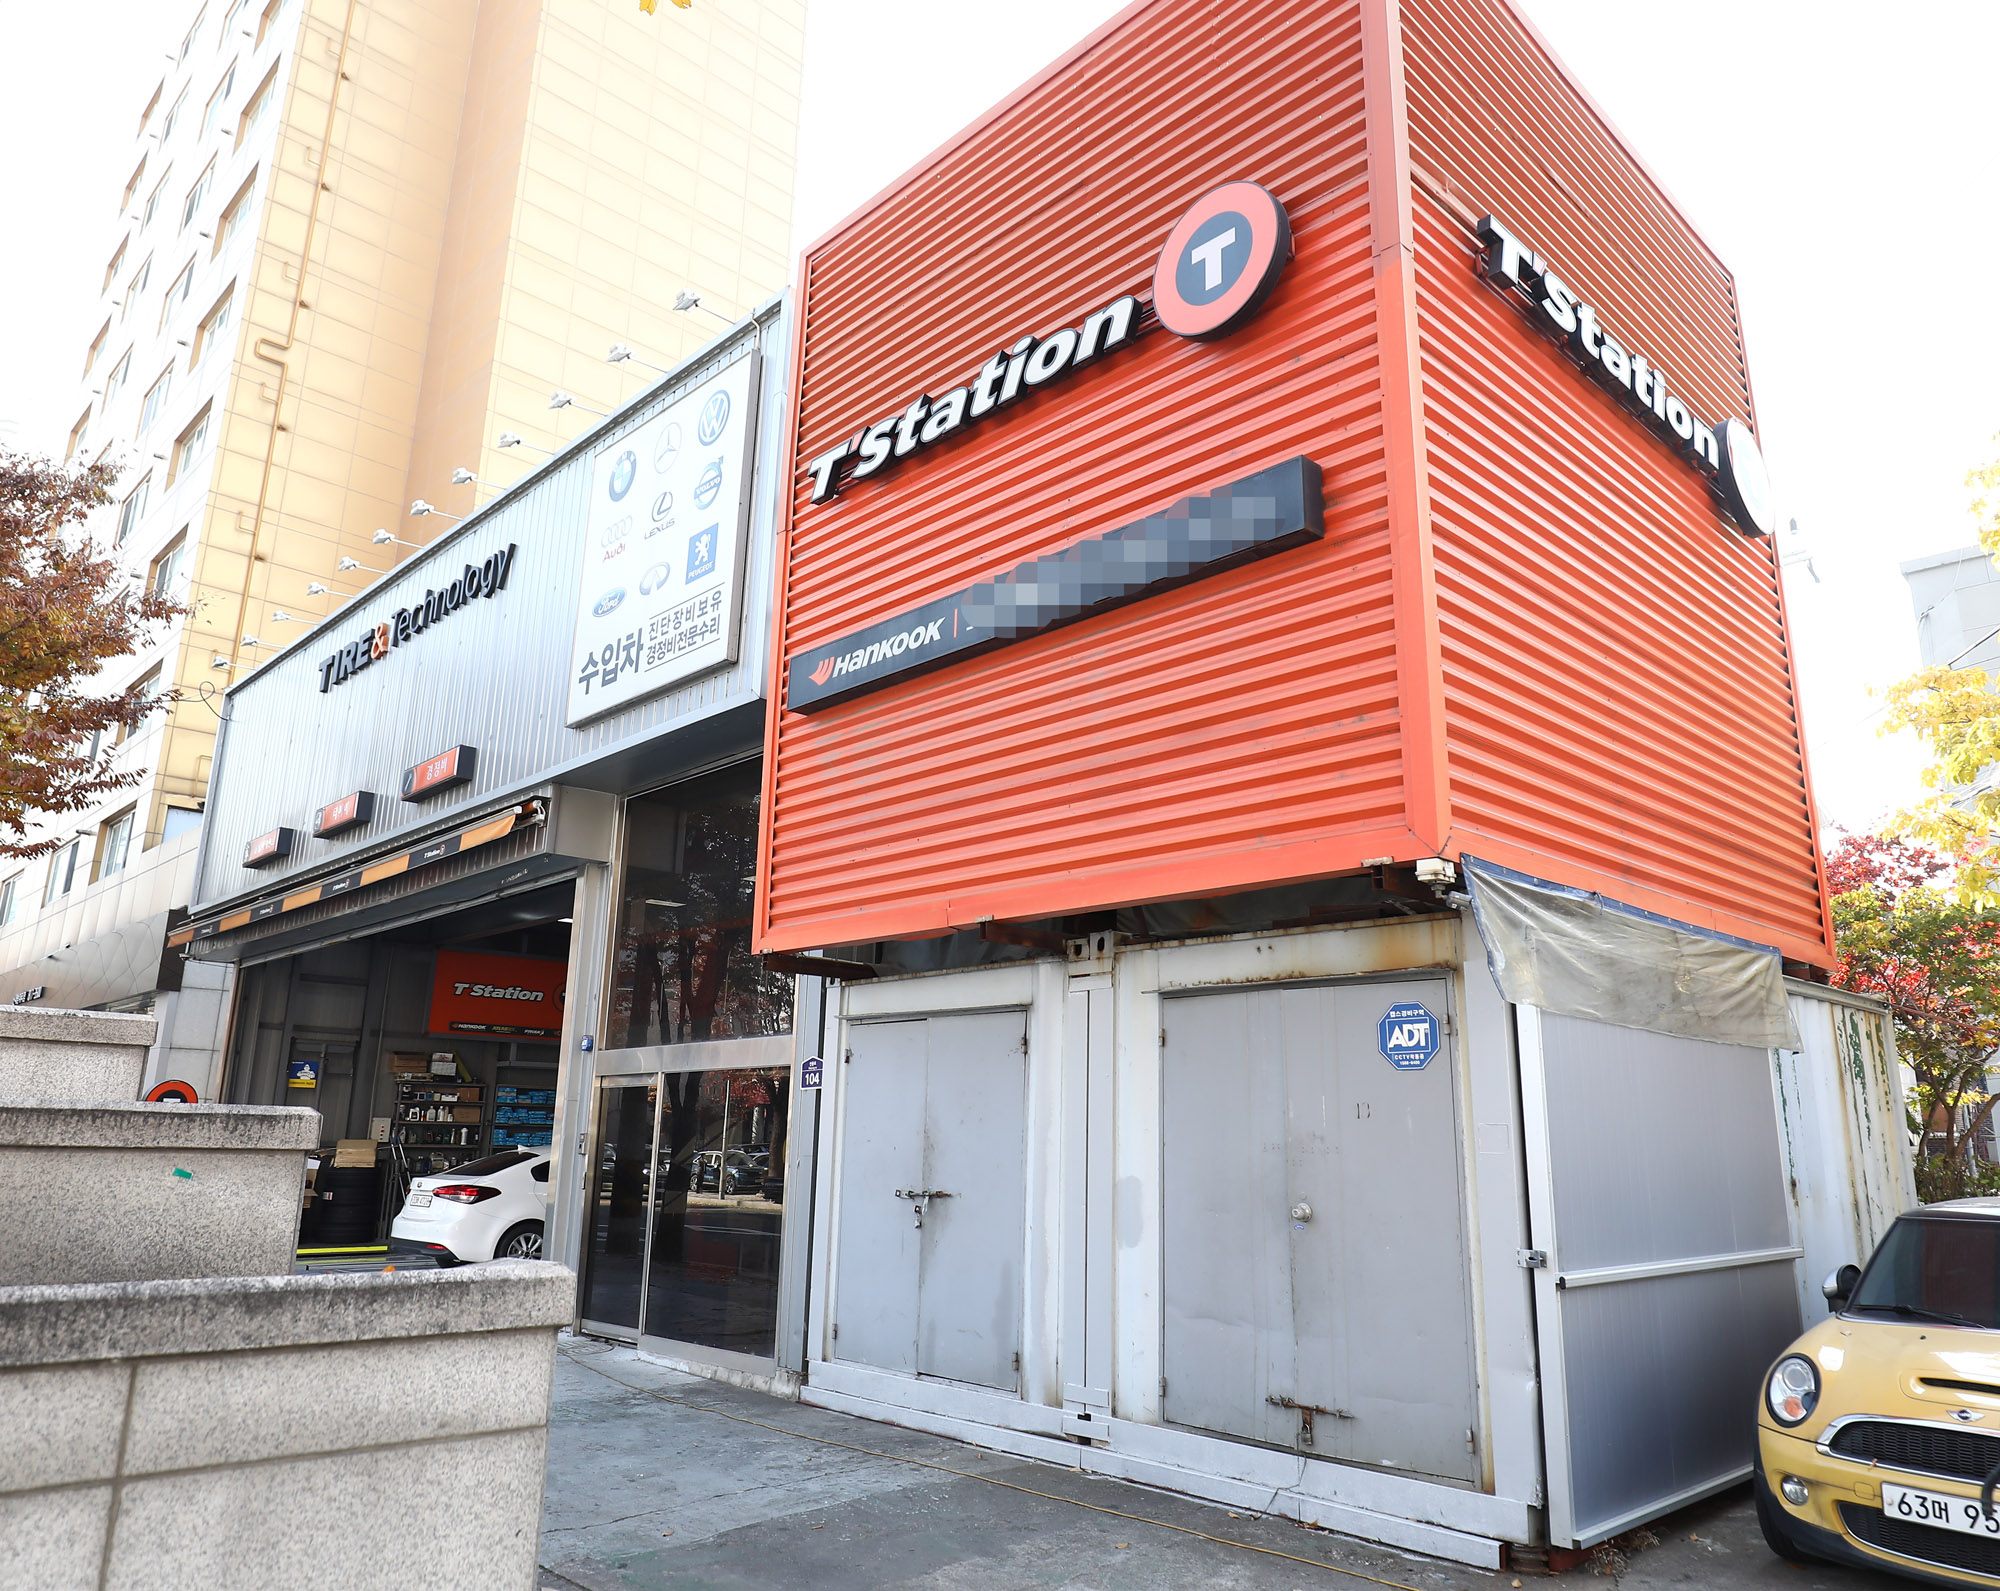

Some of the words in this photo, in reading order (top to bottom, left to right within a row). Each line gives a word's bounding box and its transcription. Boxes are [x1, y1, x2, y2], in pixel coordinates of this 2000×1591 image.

[1191, 228, 1237, 290] T
[1487, 213, 1722, 472] T'Station
[808, 294, 1140, 505] T'Station
[695, 477, 722, 495] VOLVO
[644, 518, 676, 540] LEXUS
[688, 561, 714, 580] PEUGEOT
[578, 627, 644, 695] 수입차
[453, 982, 544, 1002] T'Station
[1388, 1023, 1429, 1048] ADT
[805, 1073, 820, 1085] 104
[1897, 1492, 1950, 1524] 63머
